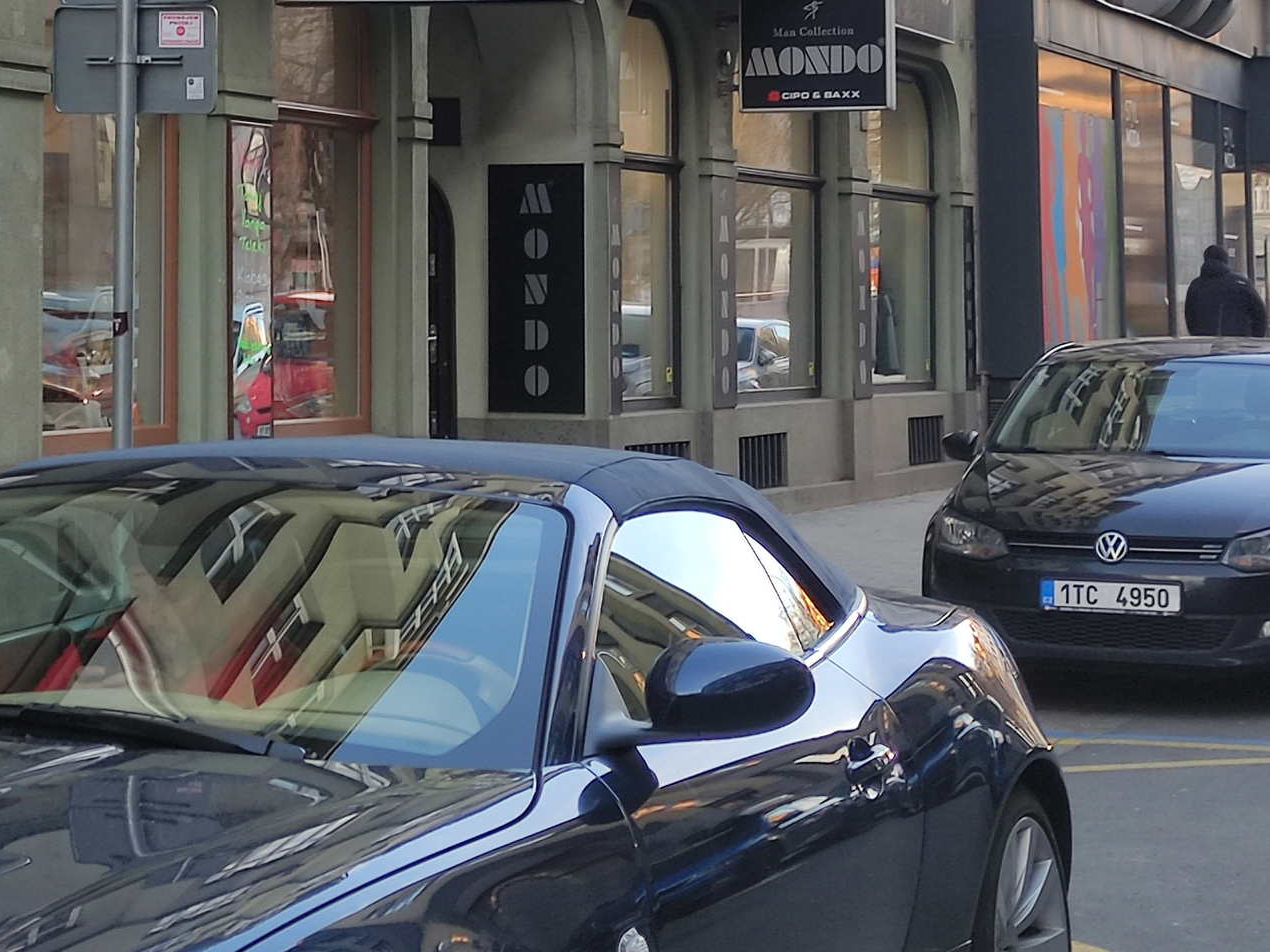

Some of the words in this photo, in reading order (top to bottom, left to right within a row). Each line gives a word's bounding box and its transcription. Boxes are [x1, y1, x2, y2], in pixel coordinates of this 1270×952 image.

[744, 43, 884, 76] MONDO
[773, 27, 796, 37] Man
[799, 25, 854, 36] Collection
[781, 92, 810, 100] CIPO
[823, 90, 861, 99] BAXX
[519, 183, 553, 397] MONDO
[610, 223, 621, 379] MONDO
[719, 215, 730, 395] MONDO
[856, 210, 867, 385] MONDO
[1060, 583, 1098, 605] 1TC
[1116, 586, 1170, 609] 4950
